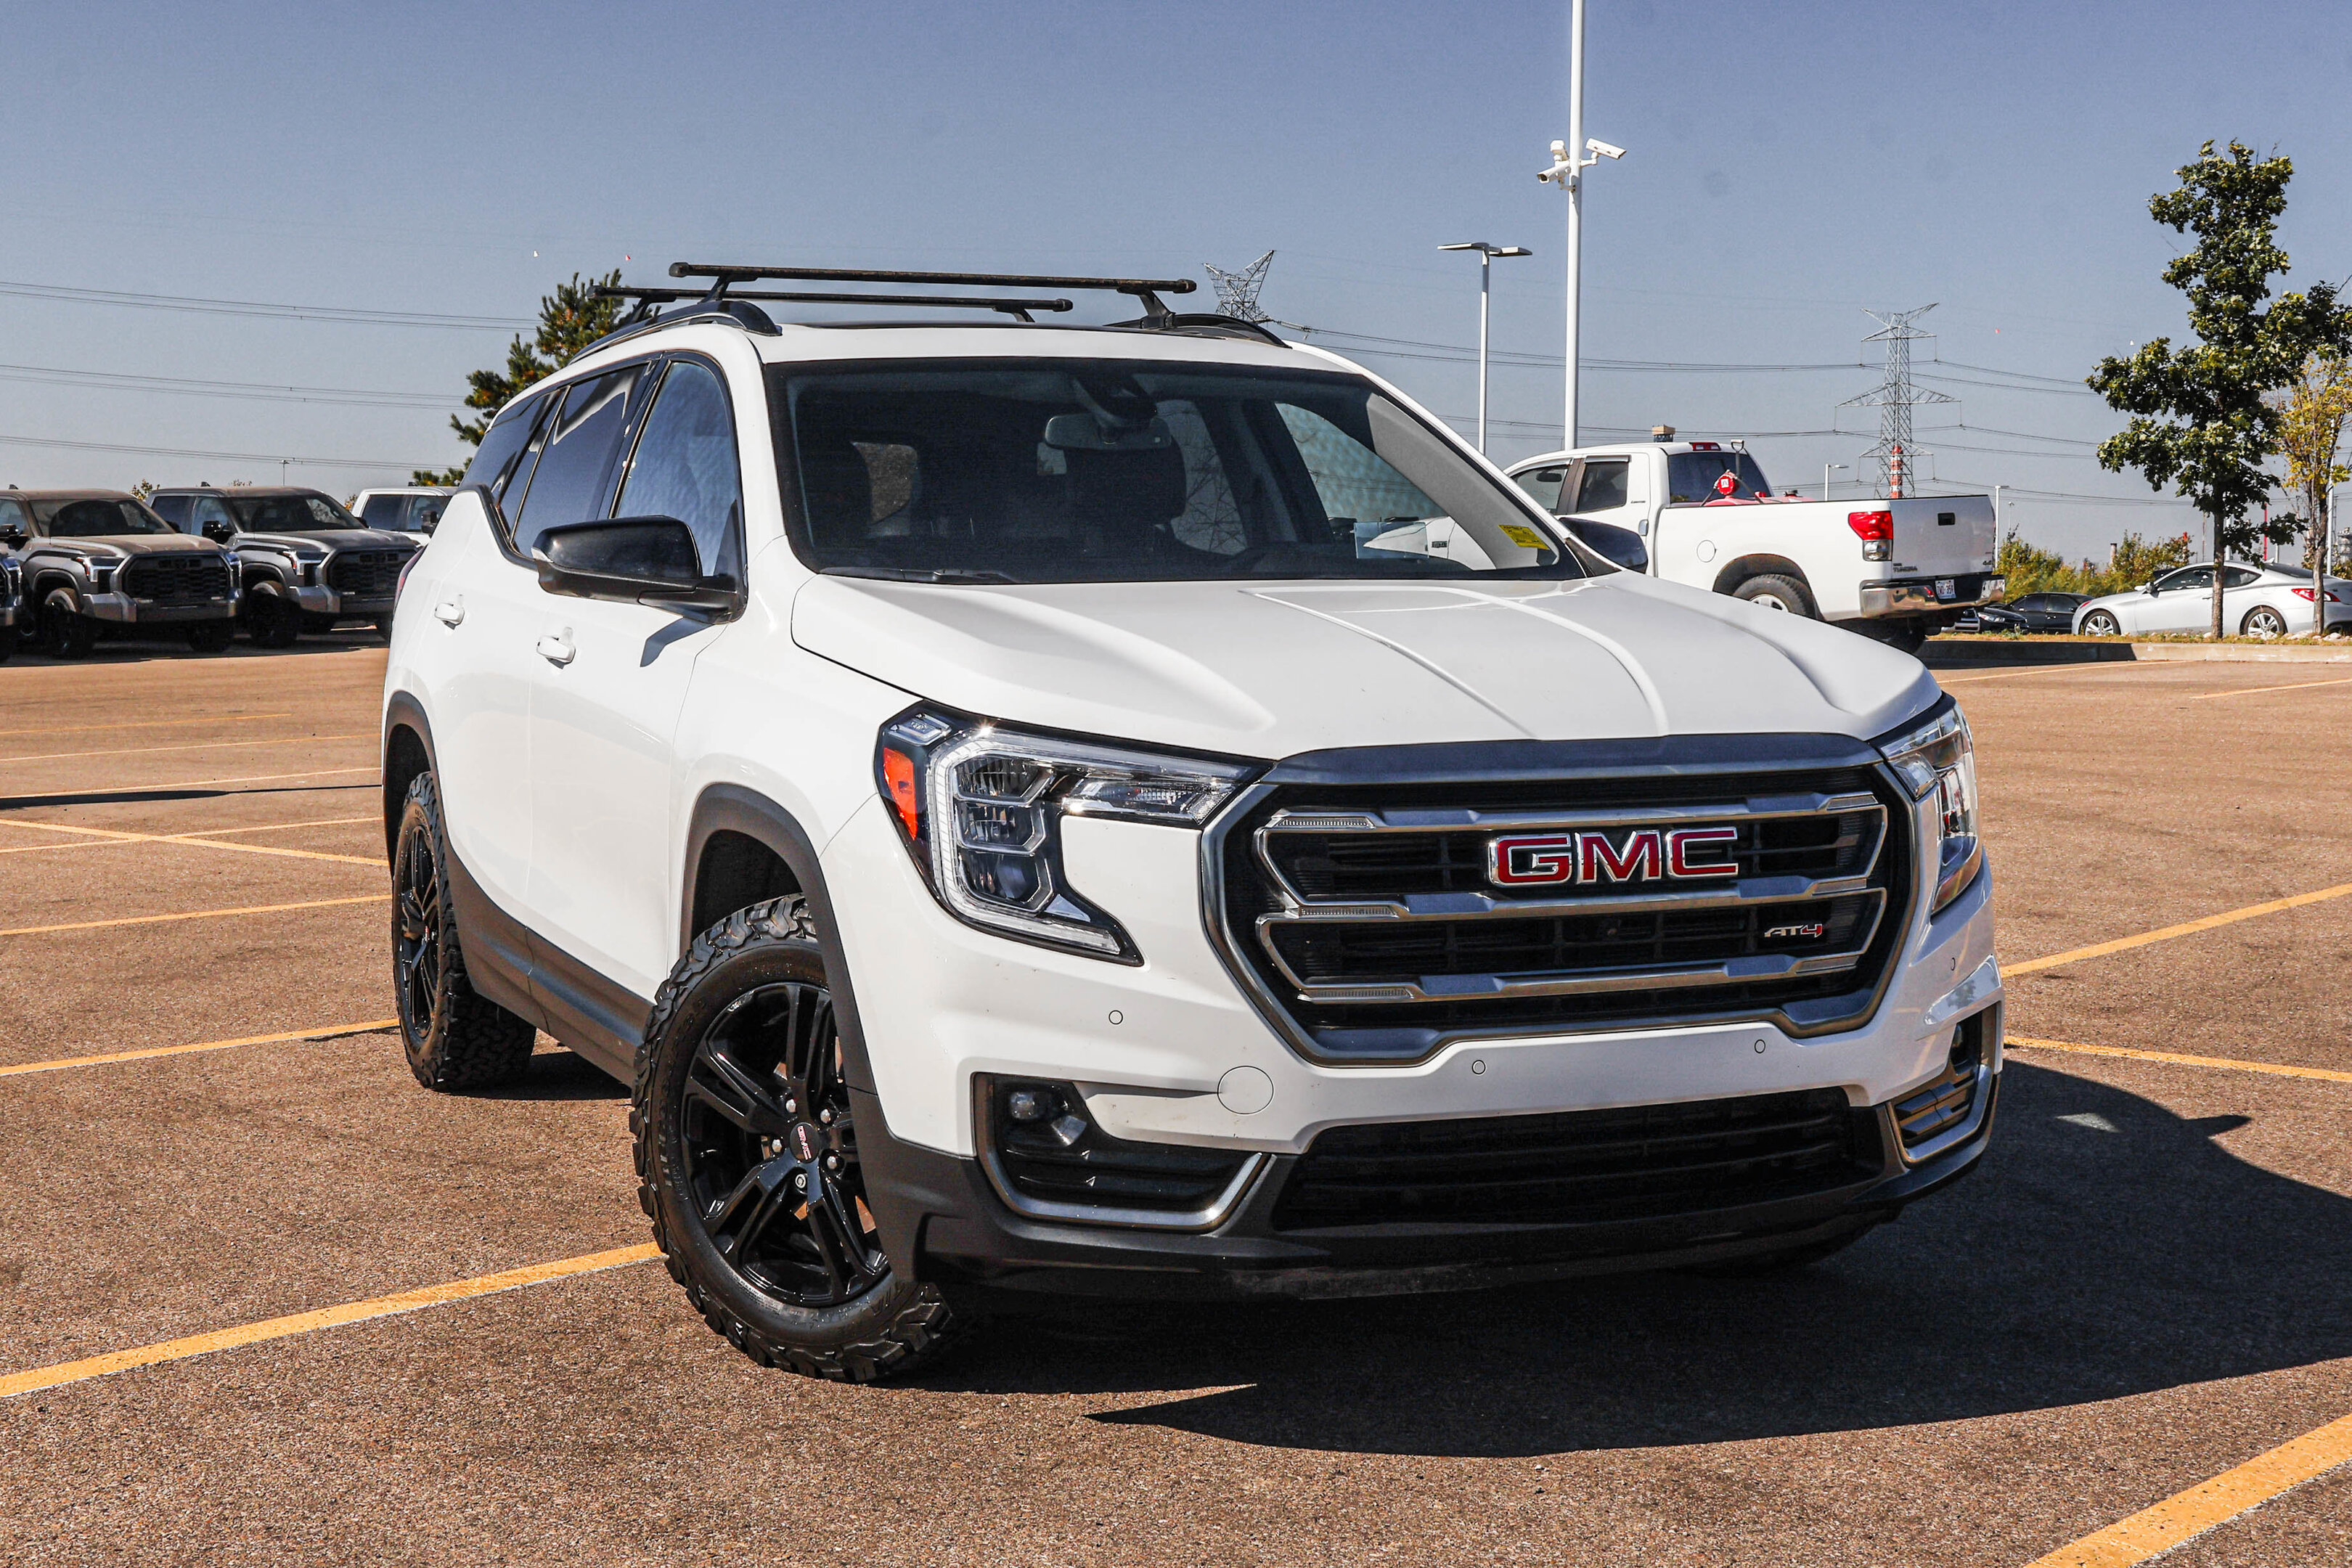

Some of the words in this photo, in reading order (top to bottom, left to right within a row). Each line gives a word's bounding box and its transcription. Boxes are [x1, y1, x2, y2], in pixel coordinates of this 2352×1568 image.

[1488, 827, 1739, 887] GMC
[1764, 923, 1823, 938] AT4
[796, 1125, 812, 1160] GMC
